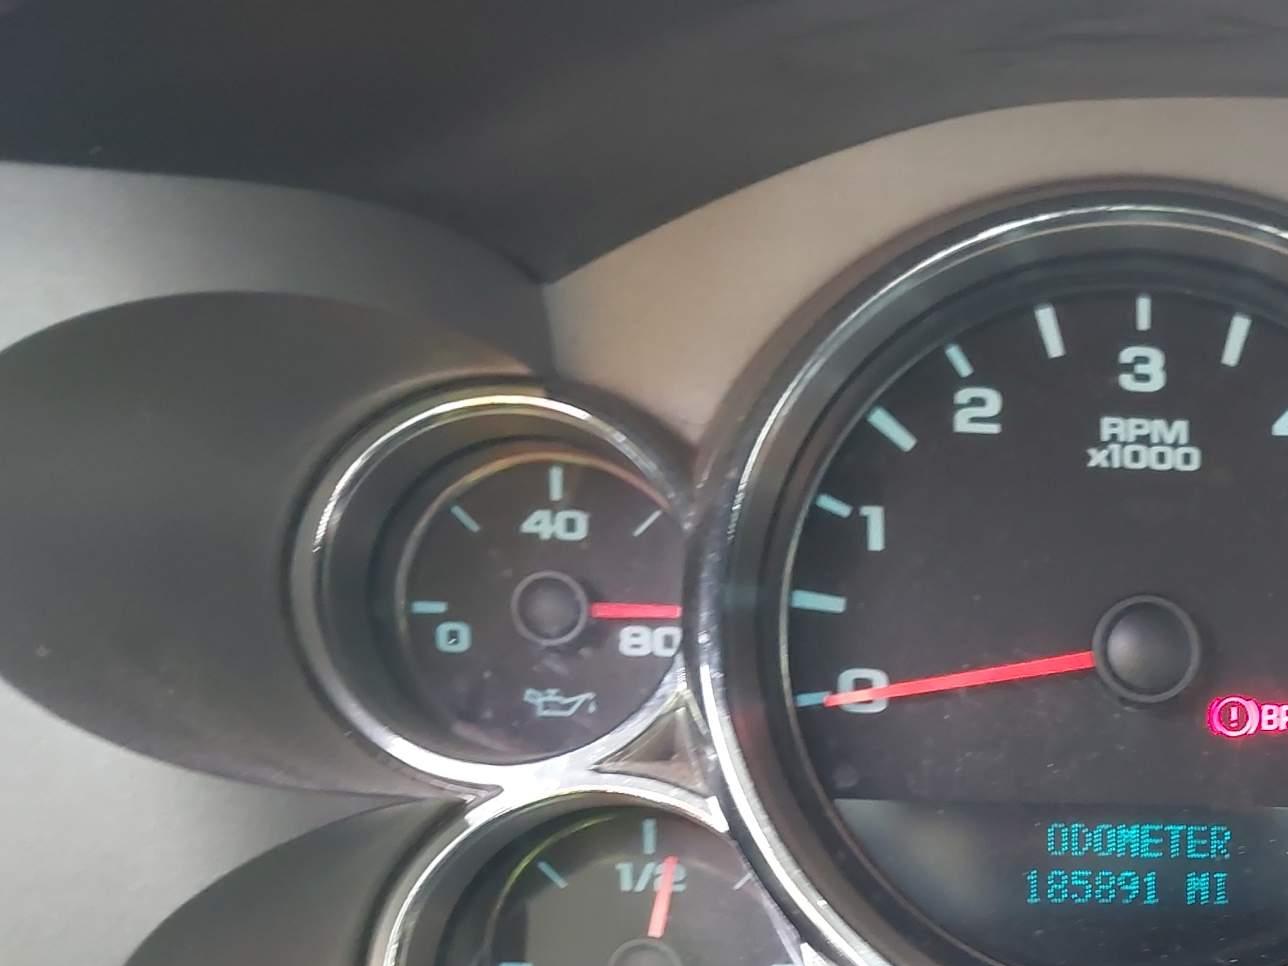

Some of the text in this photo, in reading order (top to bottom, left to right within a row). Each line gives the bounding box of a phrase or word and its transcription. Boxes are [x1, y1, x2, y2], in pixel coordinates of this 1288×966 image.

[1119, 347, 1166, 393] 3
[953, 387, 1001, 434] 2
[1100, 417, 1189, 444] RPM
[1087, 445, 1200, 472] x1000
[520, 509, 590, 541] 40
[860, 505, 885, 551] 1
[435, 621, 471, 653] 0
[618, 626, 682, 657] 80
[837, 668, 890, 714] 0
[1047, 823, 1232, 859] ODOMETER
[615, 862, 688, 893] 1/2
[1026, 870, 1229, 905] 185891 MI
